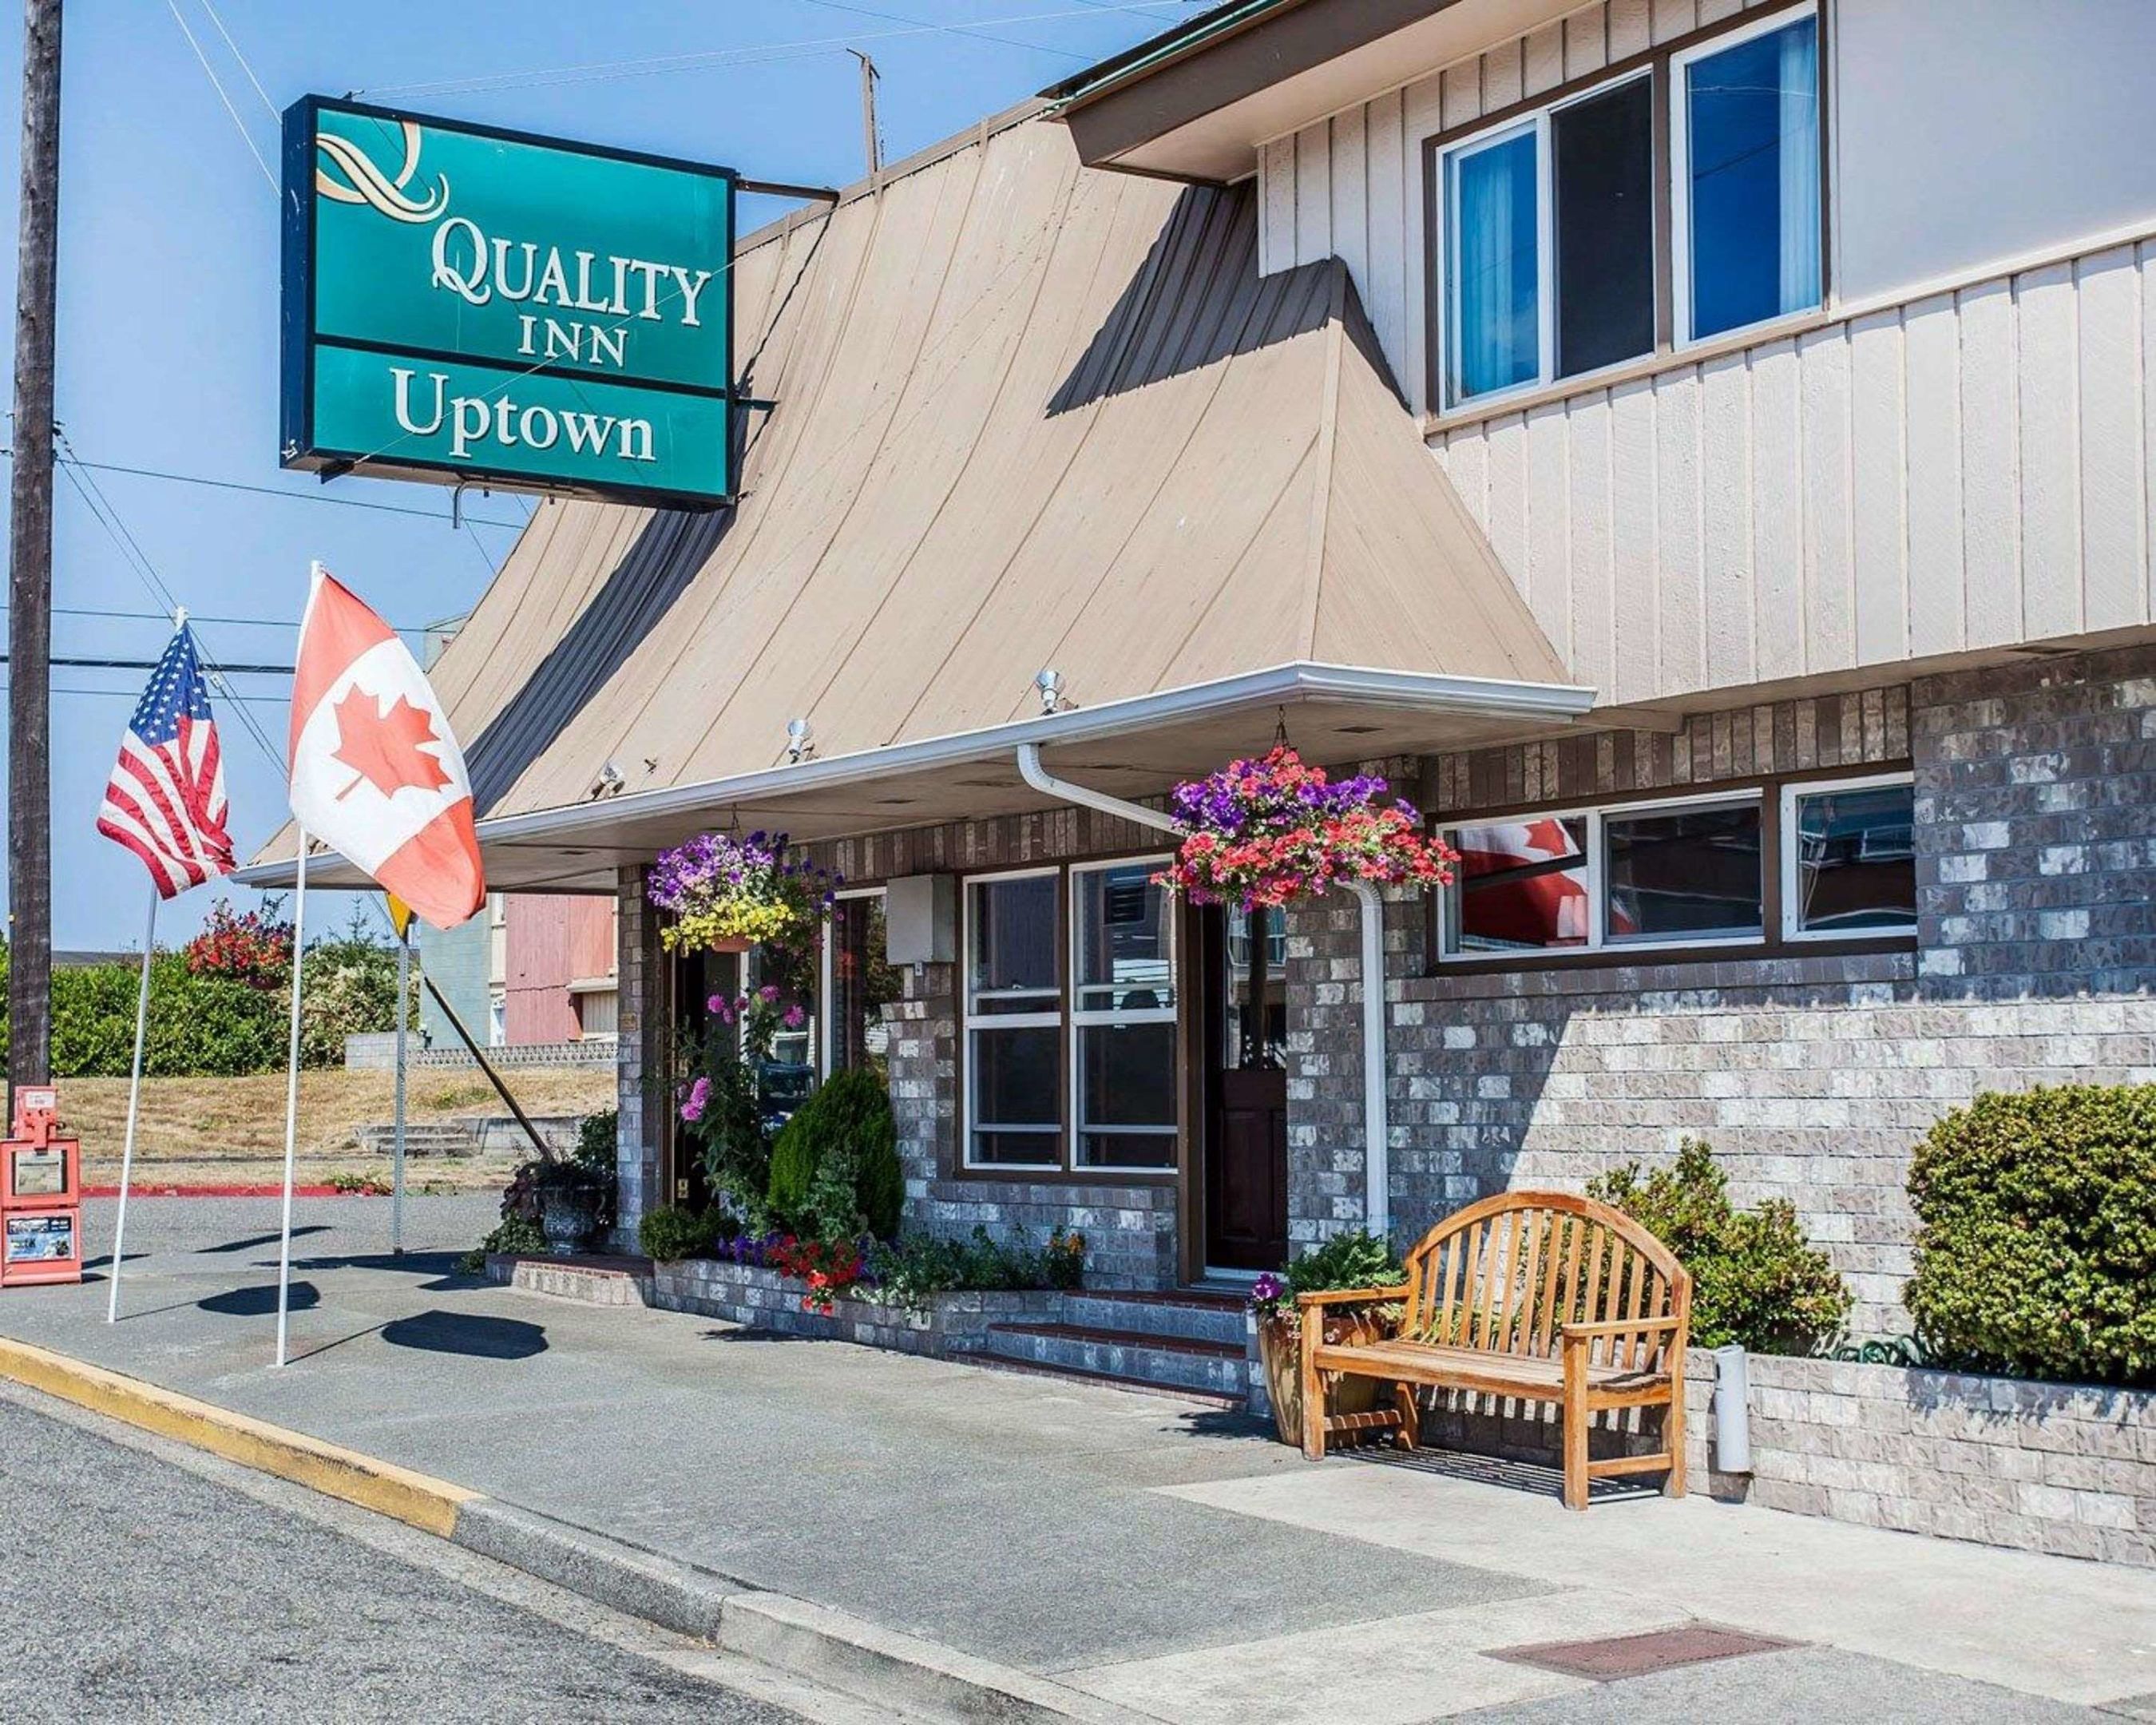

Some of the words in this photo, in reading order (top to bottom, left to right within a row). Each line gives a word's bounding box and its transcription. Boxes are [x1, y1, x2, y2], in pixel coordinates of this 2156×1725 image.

[432, 216, 711, 327] QUALITY
[517, 315, 628, 367] INN
[390, 367, 656, 462] Uptown
